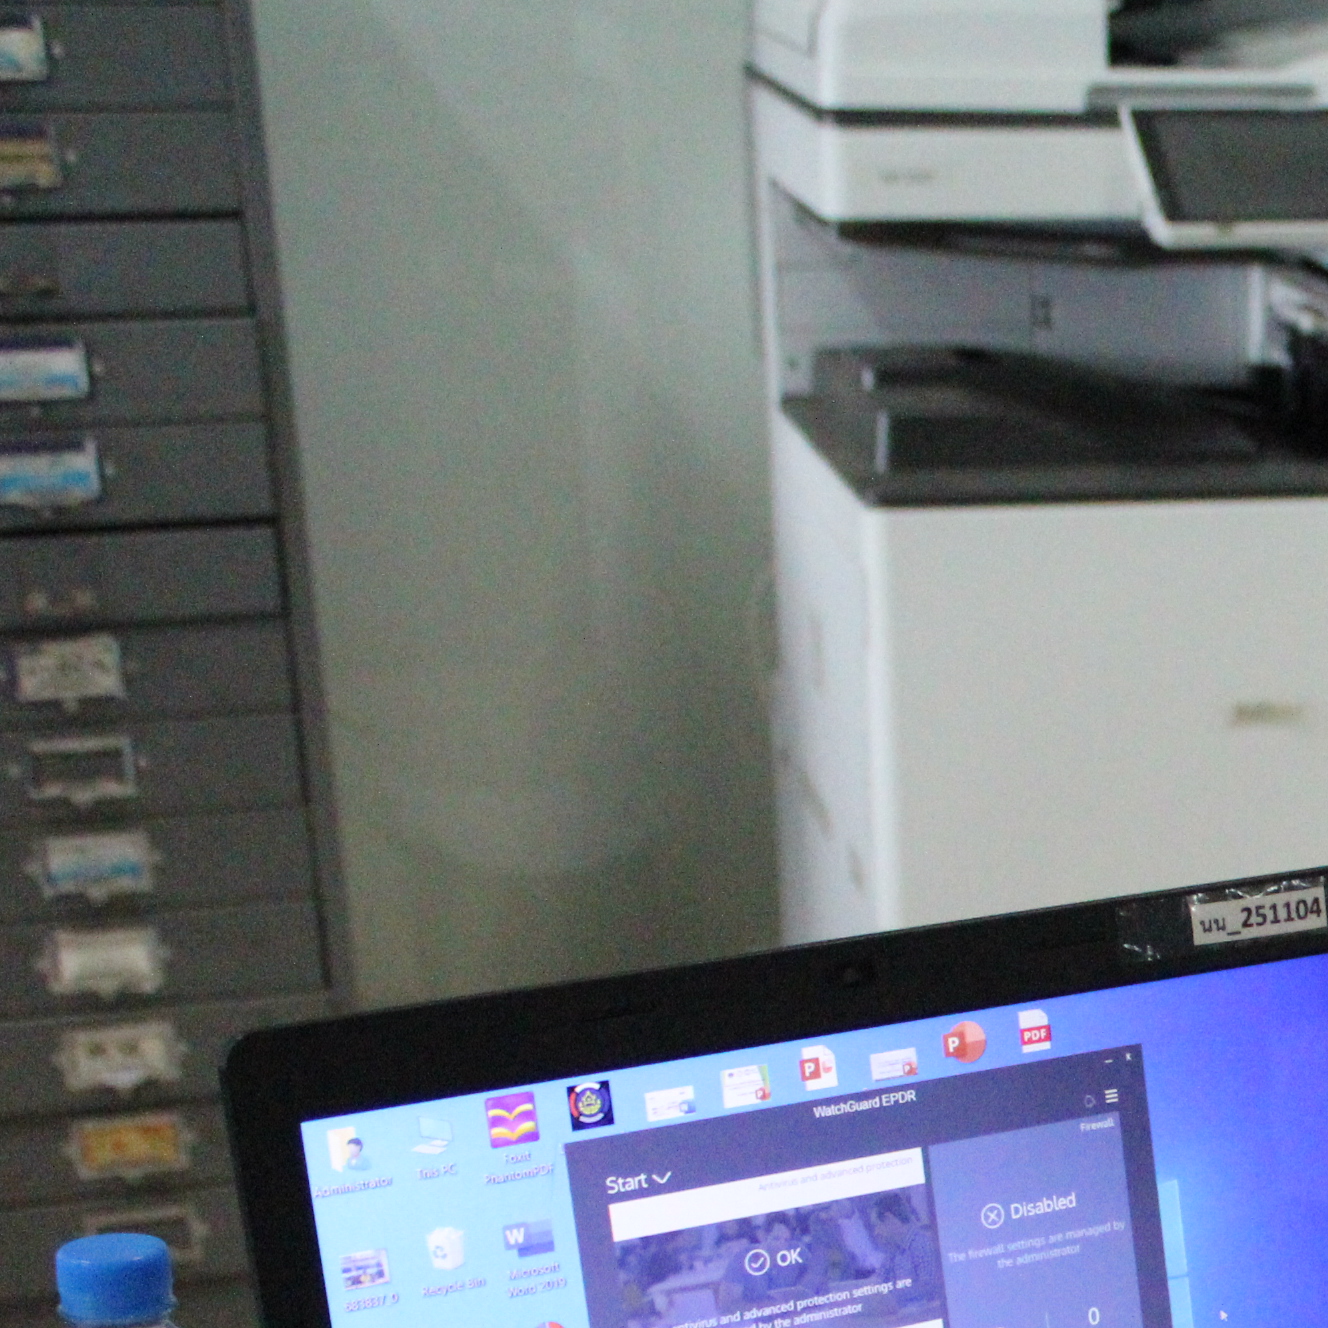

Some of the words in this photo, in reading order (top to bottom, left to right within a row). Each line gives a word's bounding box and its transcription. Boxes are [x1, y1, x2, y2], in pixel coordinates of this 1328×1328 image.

[1023, 1028, 1047, 1044] PDF
[813, 1096, 880, 1119] WatchGuard
[882, 1090, 916, 1108] EPDR
[605, 1172, 648, 1196] Start
[1010, 1192, 1077, 1220] Disabled
[1007, 1234, 1046, 1253] settings
[1048, 1232, 1063, 1244] are
[1065, 1222, 1110, 1242] managed
[1113, 1219, 1126, 1234] by
[777, 1247, 803, 1268] OK
[997, 1256, 1014, 1269] the
[1016, 1243, 1081, 1266] administrator
[720, 1311, 741, 1326] and
[743, 1300, 794, 1321] advanced
[796, 1289, 849, 1314] protection
[852, 1281, 892, 1303] settings
[895, 1278, 912, 1290] are
[793, 1301, 863, 1327] administrator
[1088, 1306, 1100, 1326] 0
